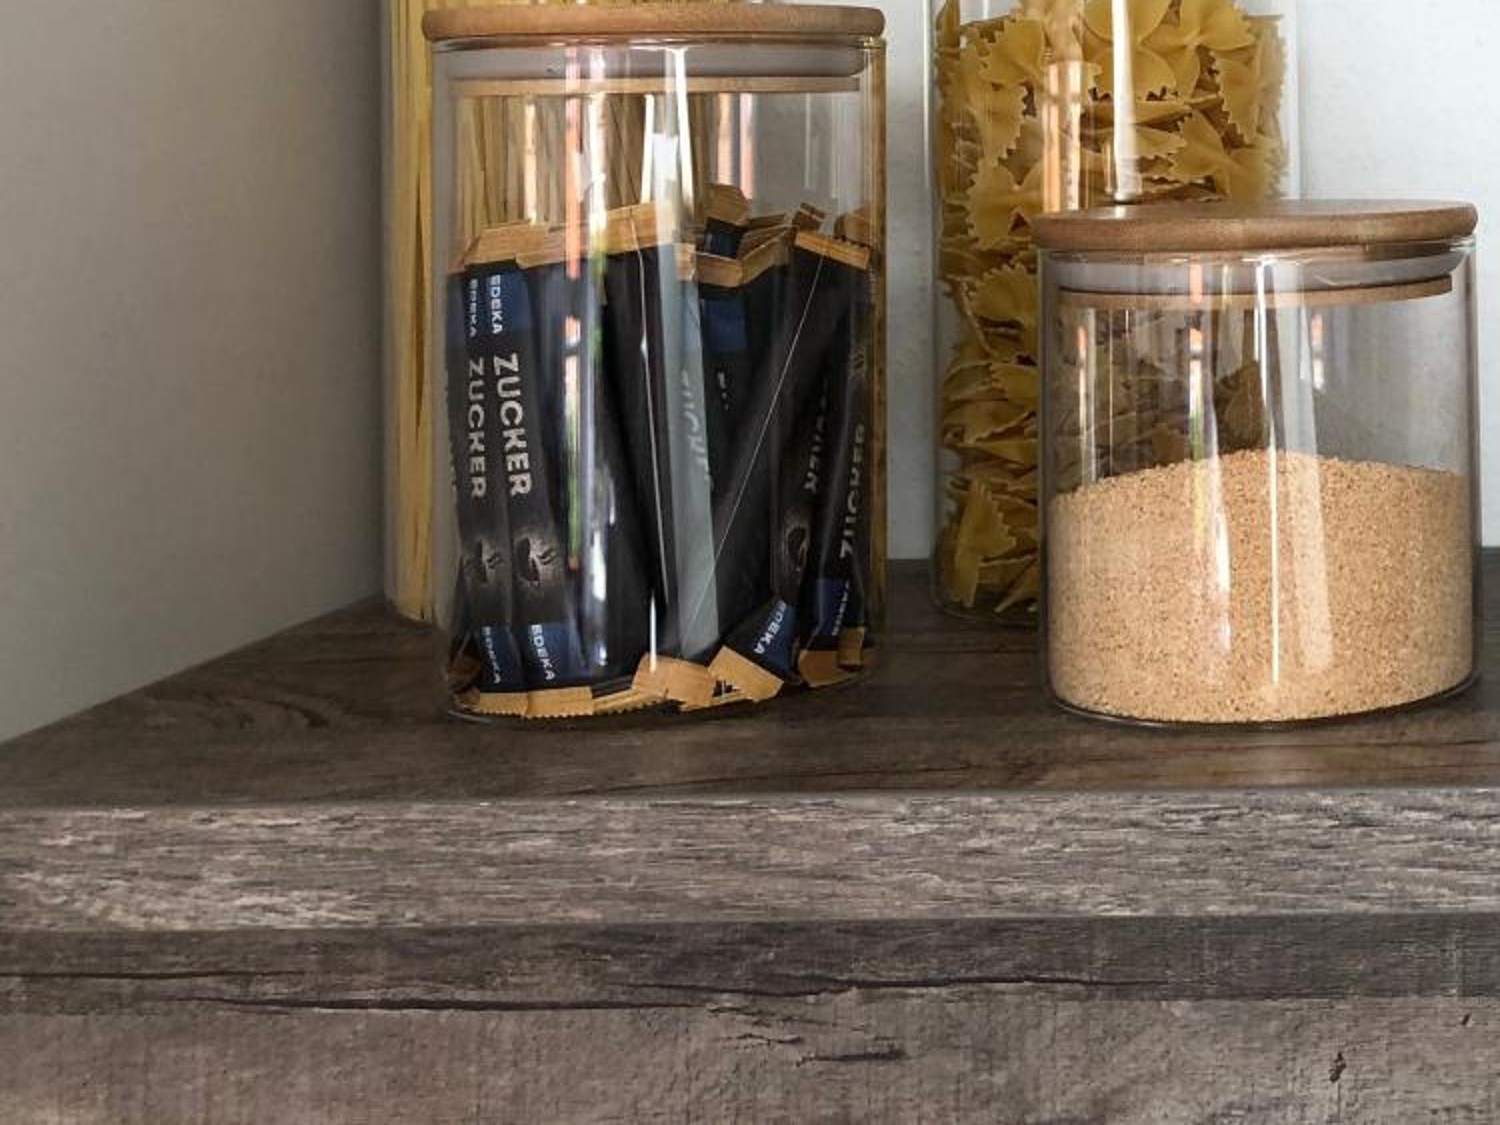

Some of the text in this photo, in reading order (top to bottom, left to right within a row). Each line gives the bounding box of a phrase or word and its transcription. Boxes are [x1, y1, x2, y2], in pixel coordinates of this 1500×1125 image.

[489, 274, 503, 335] EDEKA
[467, 356, 488, 499] ZUCKER
[493, 352, 533, 498] ZUCKER
[530, 624, 556, 681] EDEKA
